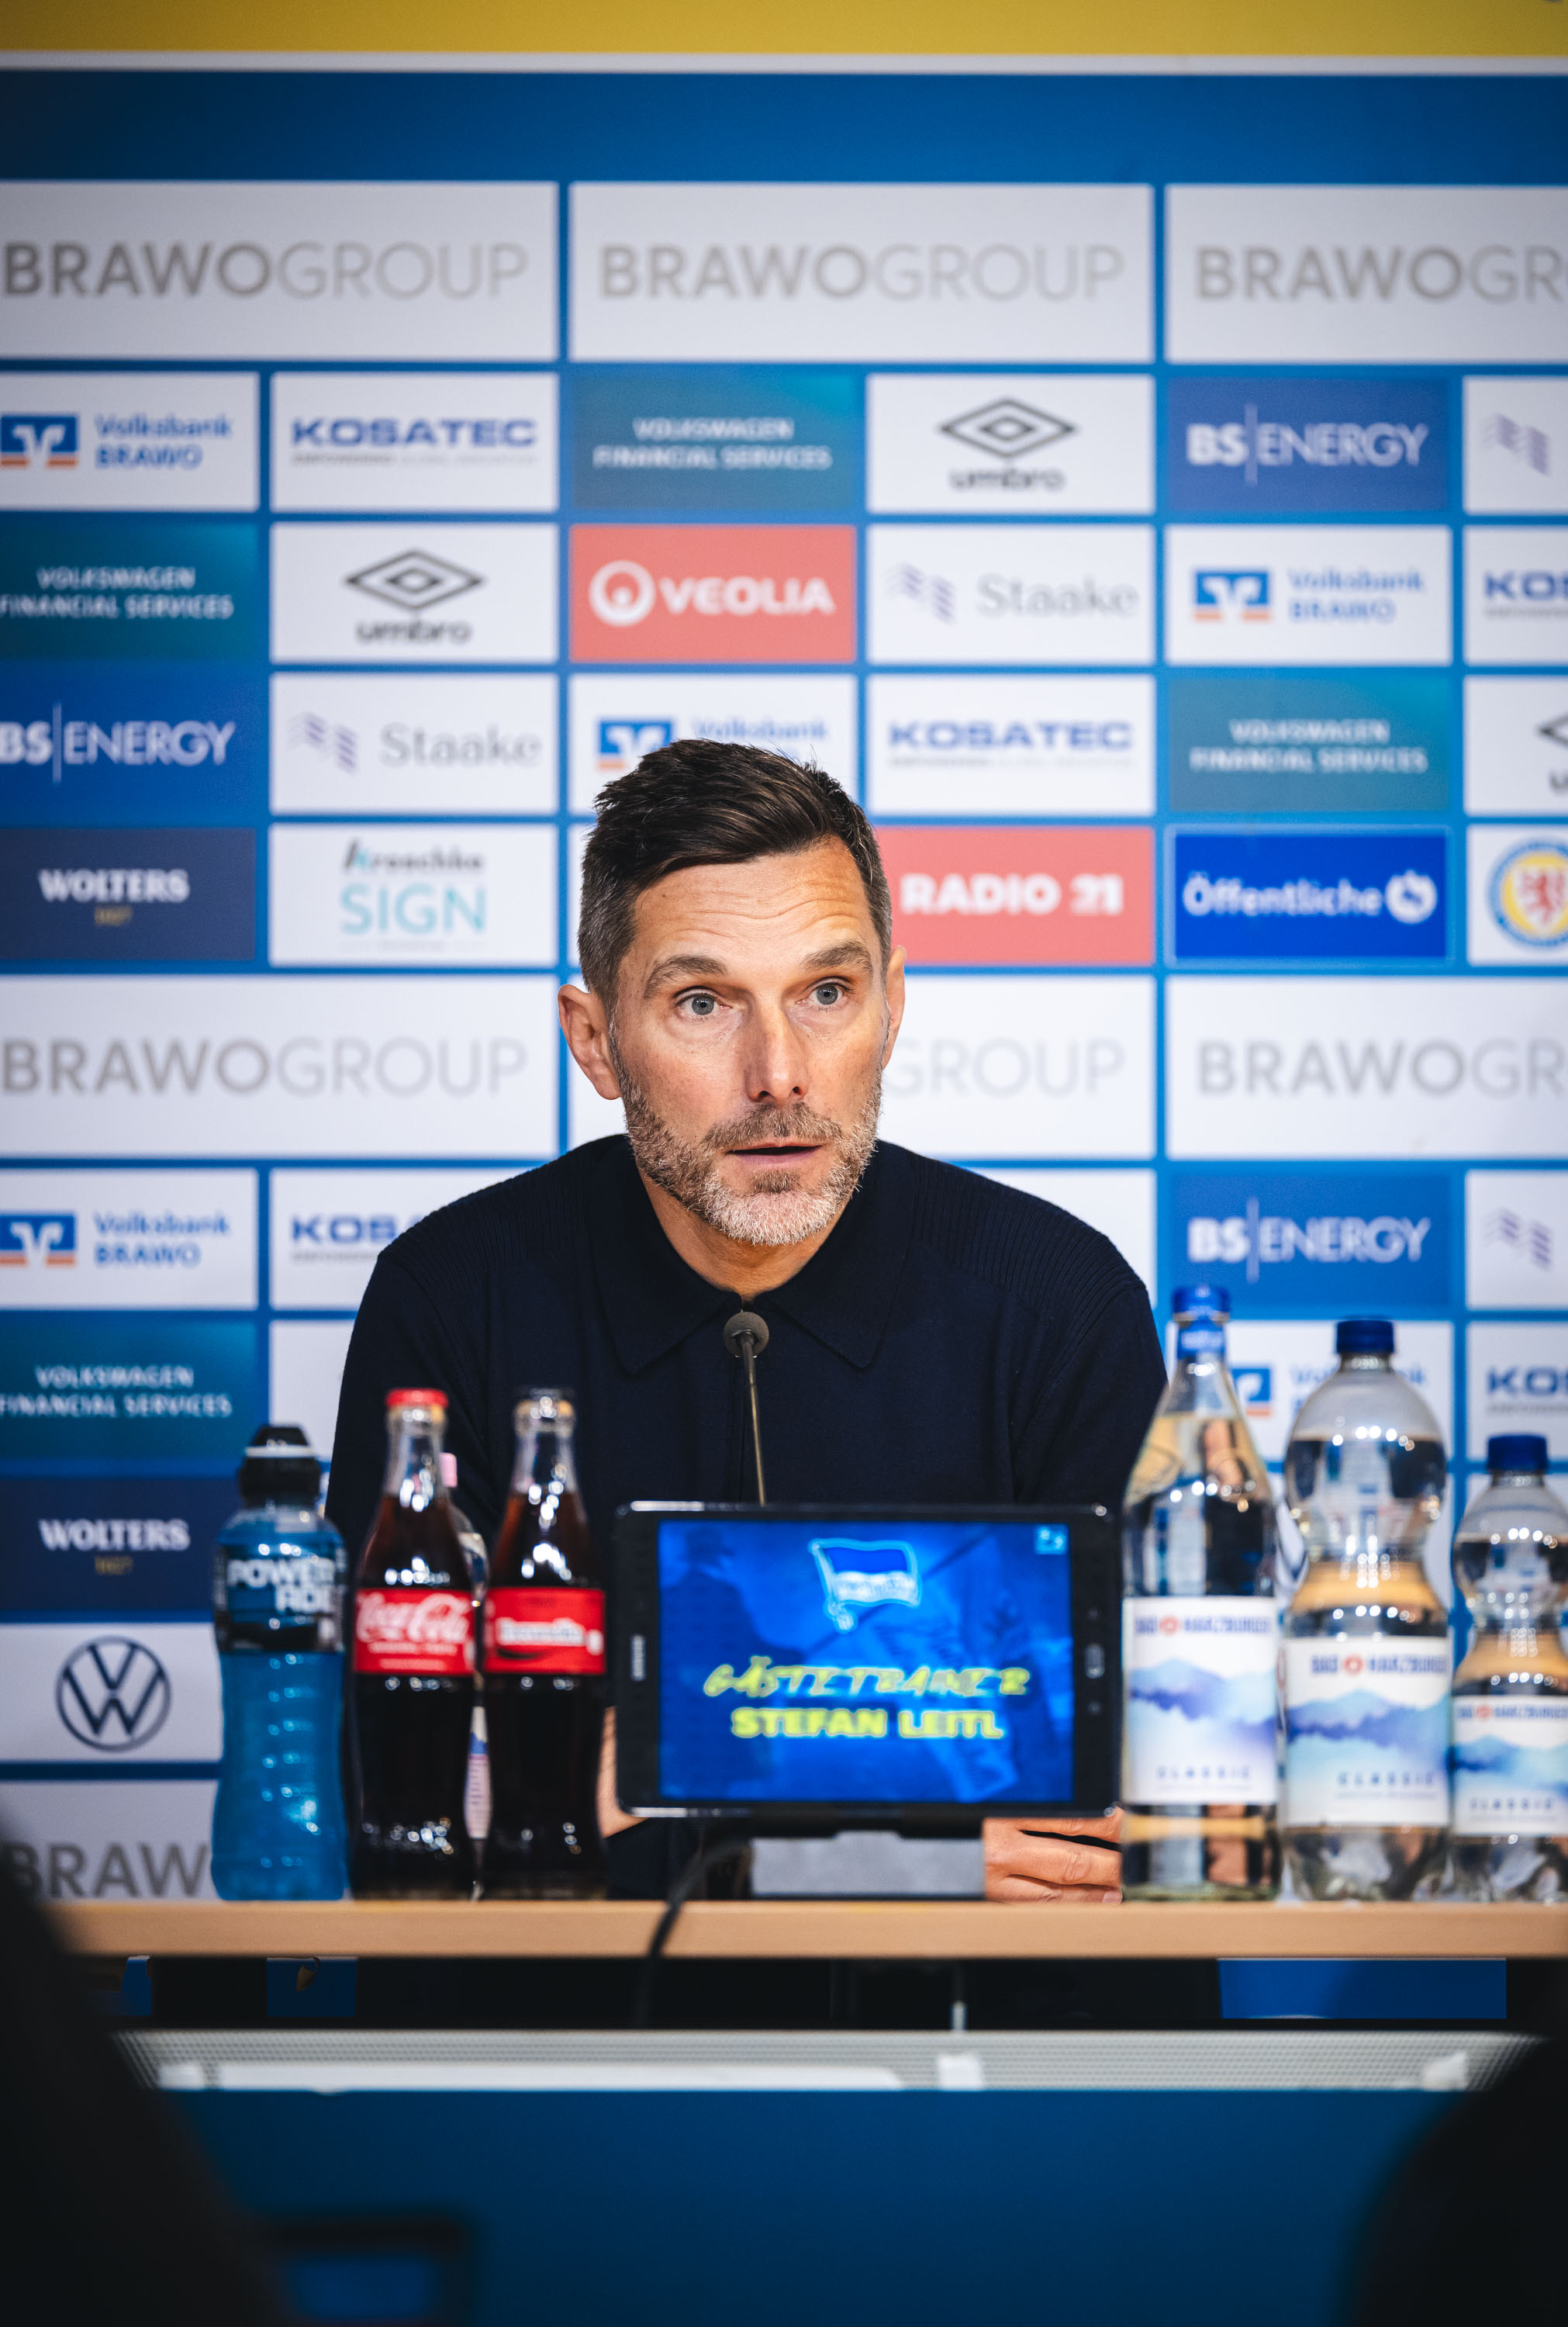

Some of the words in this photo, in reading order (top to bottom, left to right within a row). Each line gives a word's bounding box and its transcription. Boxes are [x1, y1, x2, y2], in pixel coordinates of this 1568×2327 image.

[3, 240, 530, 300] BRAWOGROUP
[599, 243, 1125, 303] BRAWOGROUP
[1194, 244, 1568, 303] BRAWOGR
[94, 413, 232, 440] Volksbank
[291, 418, 537, 448] KOSATEC
[631, 417, 795, 441] VOLKSWAGEN
[95, 444, 204, 470] BRAWO
[592, 445, 717, 469] FINANCIAL
[723, 445, 834, 469] SERVICES
[948, 465, 1065, 492] umbro
[37, 566, 195, 590] VOLKSWAGEN
[1287, 568, 1424, 593] Volksbank
[124, 593, 233, 619] SERVICES
[660, 576, 835, 615] VEOLIA
[976, 572, 1139, 617] Staake
[1288, 597, 1397, 624] BRAWO
[356, 617, 472, 645] umbro
[380, 723, 543, 768] Staake
[888, 721, 1134, 751] KOSATEC
[1228, 718, 1390, 744] VOLKSWAGEN
[1189, 747, 1313, 773] FINANCIAL
[1318, 747, 1430, 773] SERVICES
[39, 869, 190, 902] WOLTERS
[900, 873, 1062, 915] RADIO
[1071, 873, 1124, 915] 21
[1183, 869, 1383, 916] Öffentliche
[340, 883, 487, 935] SIGN
[2, 1036, 528, 1097] BRAWOGROUP
[1197, 1038, 1568, 1098] BRAWOGR
[93, 1212, 229, 1237] Volksbank
[291, 1214, 428, 1245] KOS
[94, 1243, 200, 1268] BRAWO
[35, 1365, 194, 1388] VOLKSWAGEN
[123, 1394, 232, 1418] SERVICES
[39, 1519, 191, 1551] WOLTERS
[731, 1707, 888, 1738] STEFAN
[897, 1710, 1004, 1738] LEITL
